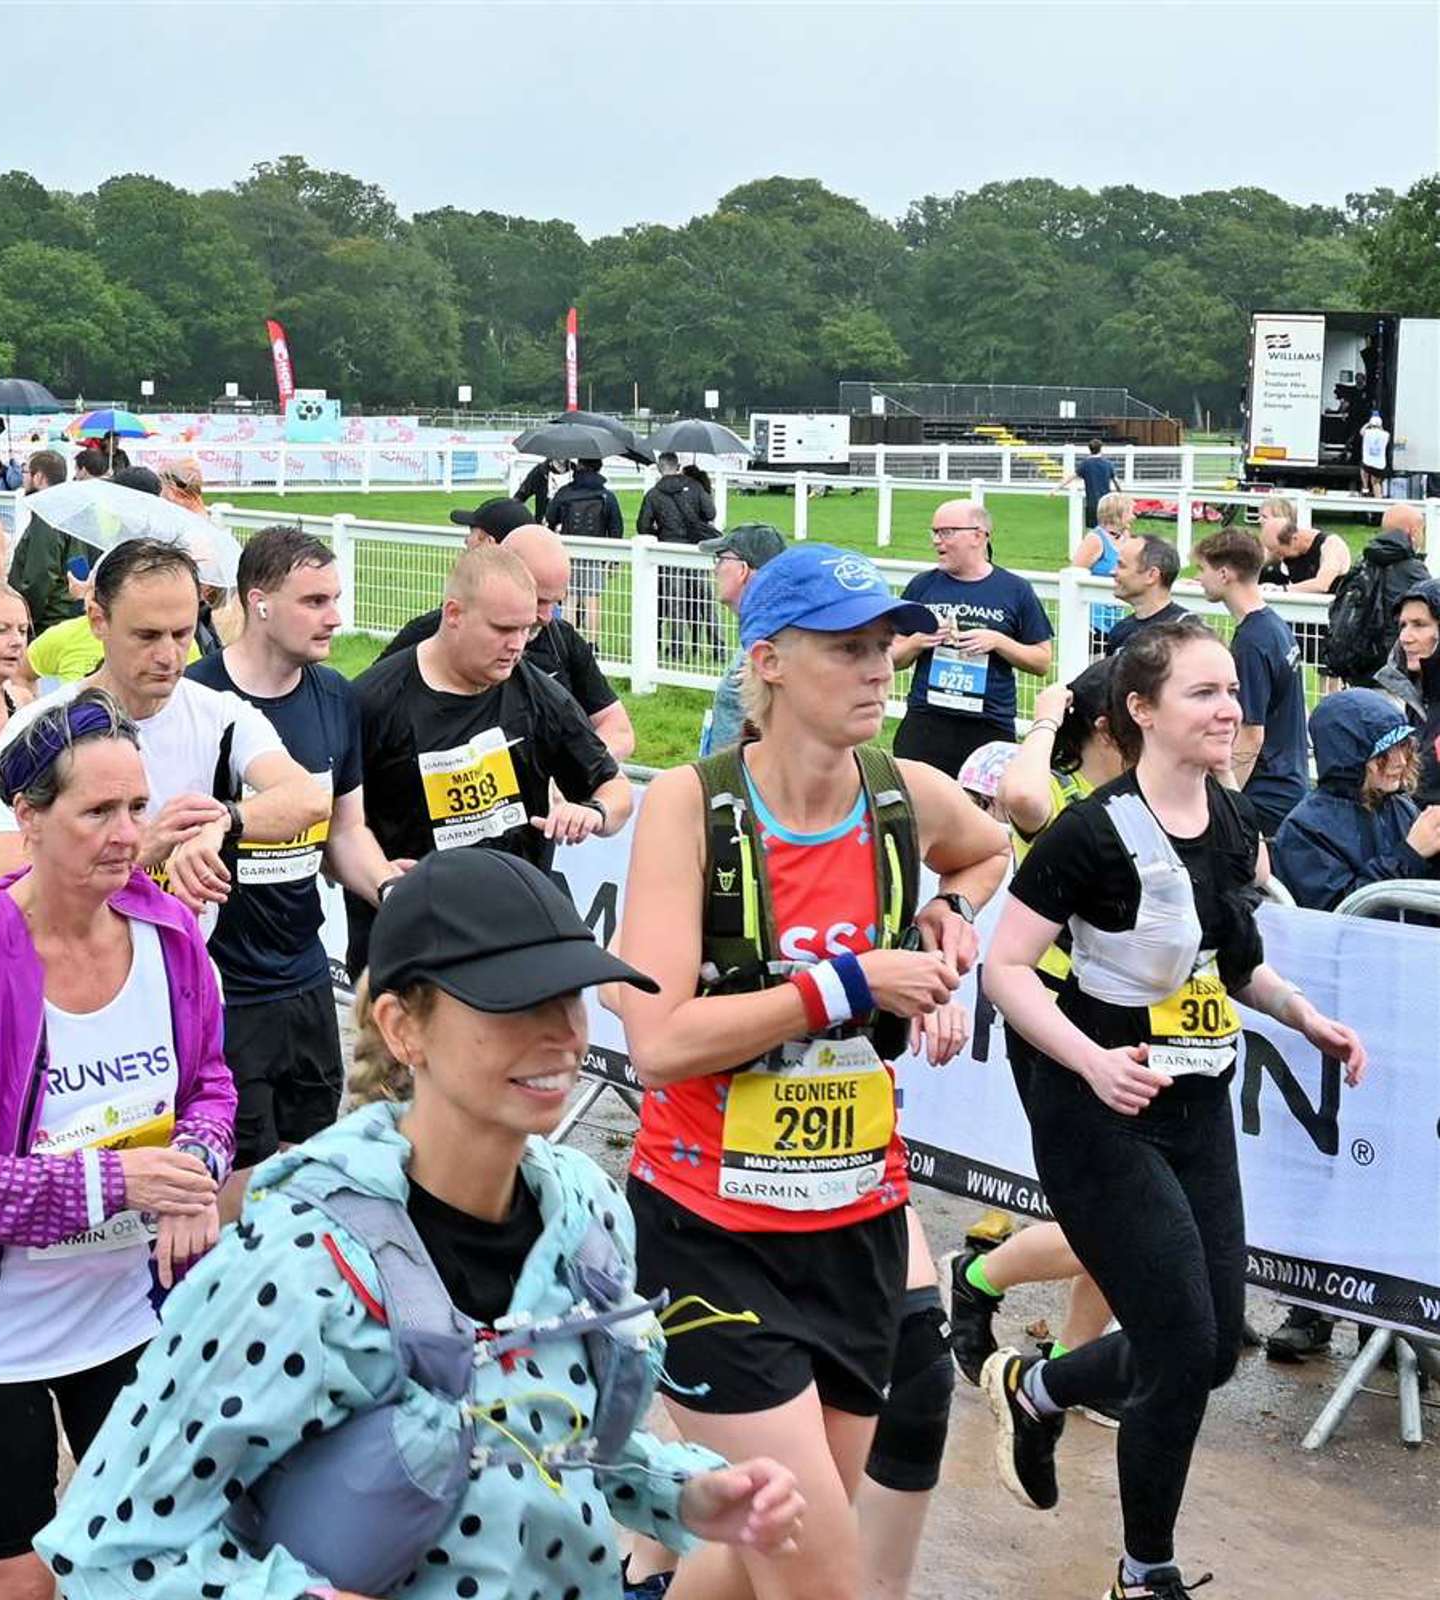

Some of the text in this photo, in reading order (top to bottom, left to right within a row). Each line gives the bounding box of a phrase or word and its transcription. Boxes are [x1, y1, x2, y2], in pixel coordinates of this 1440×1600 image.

[1268, 352, 1322, 362] WILLIAMS
[938, 670, 974, 692] 6275
[239, 865, 287, 876] GARMIN
[1152, 1054, 1215, 1068] GARMIN
[774, 1080, 857, 1102] LEONIEKE
[773, 1105, 855, 1151] 2911
[724, 1181, 809, 1199] GARMIN
[55, 1229, 106, 1246] RMIN
[1245, 1254, 1377, 1305] ARMIN.COM
